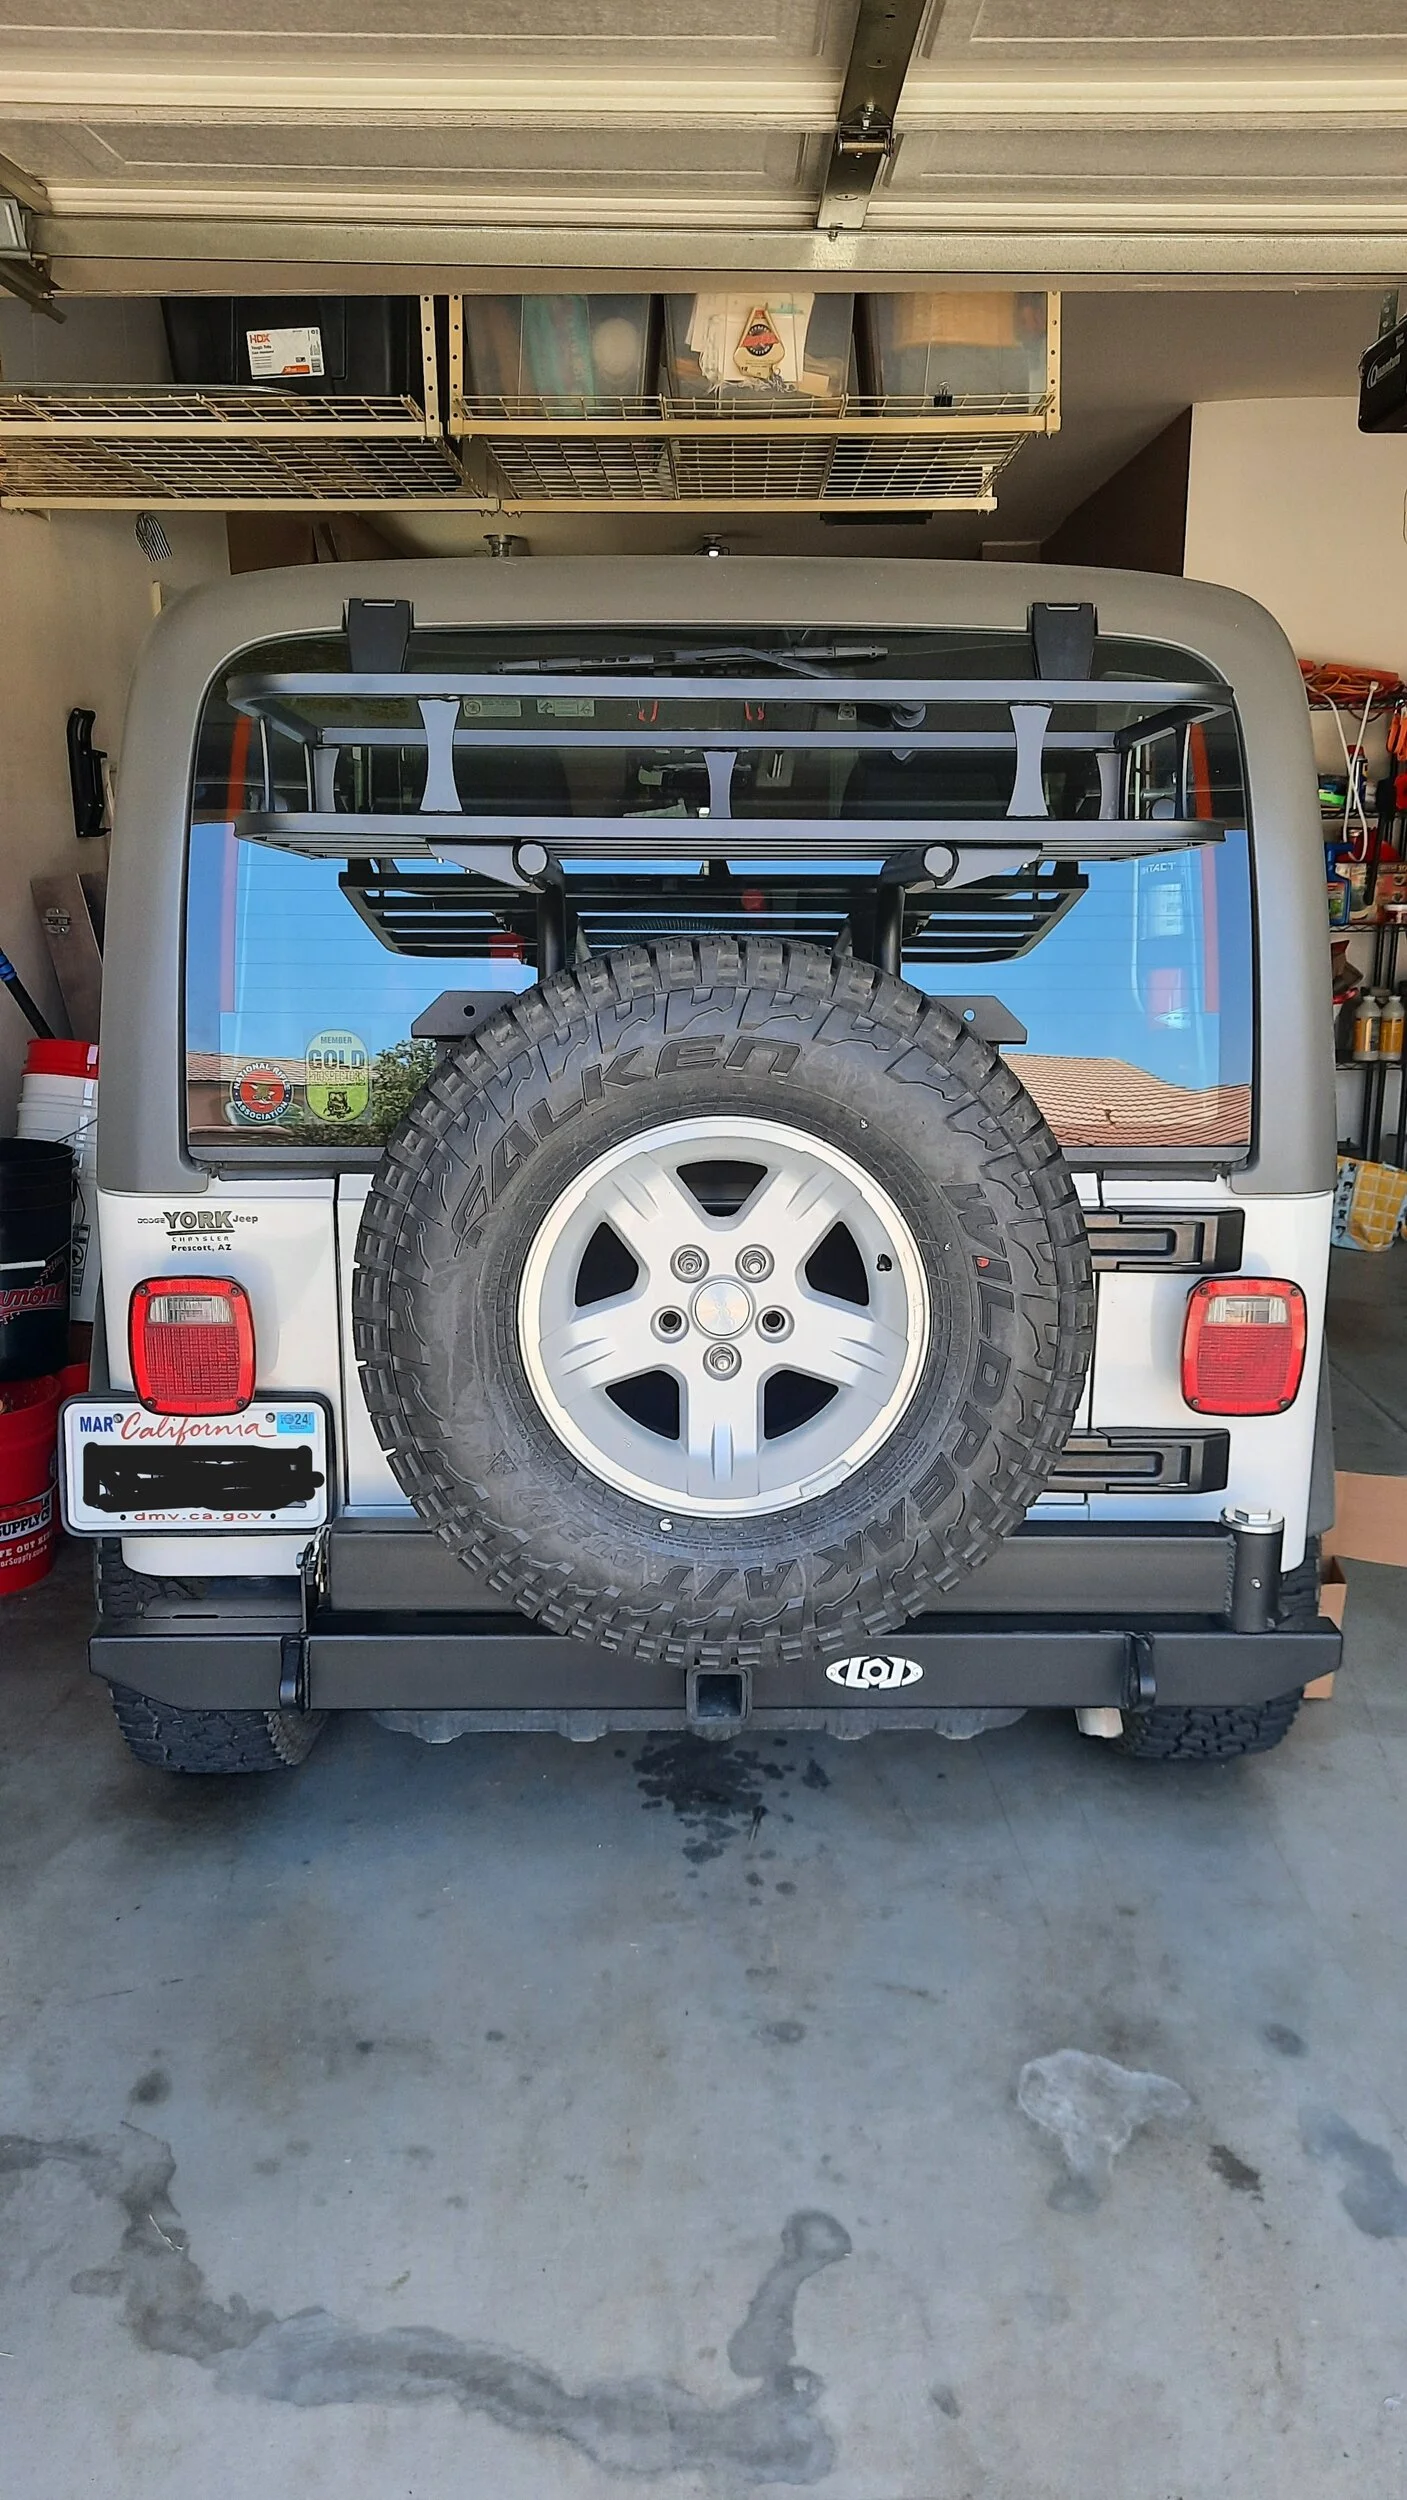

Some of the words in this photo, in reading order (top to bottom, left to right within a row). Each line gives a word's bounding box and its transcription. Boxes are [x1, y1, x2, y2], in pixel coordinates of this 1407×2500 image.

[249, 333, 271, 344] HDX
[320, 1036, 353, 1044] MEMBER
[307, 1049, 366, 1070] GOLD
[233, 1062, 271, 1090] NATIONAL
[271, 1065, 292, 1091] RIFLE
[235, 1100, 290, 1121] ASSOCIATION
[451, 1035, 802, 1258] FALKEN
[162, 1210, 234, 1229] YORK
[232, 1215, 259, 1224] Jeep
[171, 1244, 215, 1252] Prescott,
[217, 1243, 232, 1251] AZ
[812, 1182, 1015, 1588] WILDPEAK
[80, 1416, 114, 1433] MAR
[120, 1411, 278, 1446] California
[294, 1413, 309, 1425] 24
[134, 1511, 263, 1523] dmv.ca.gov
